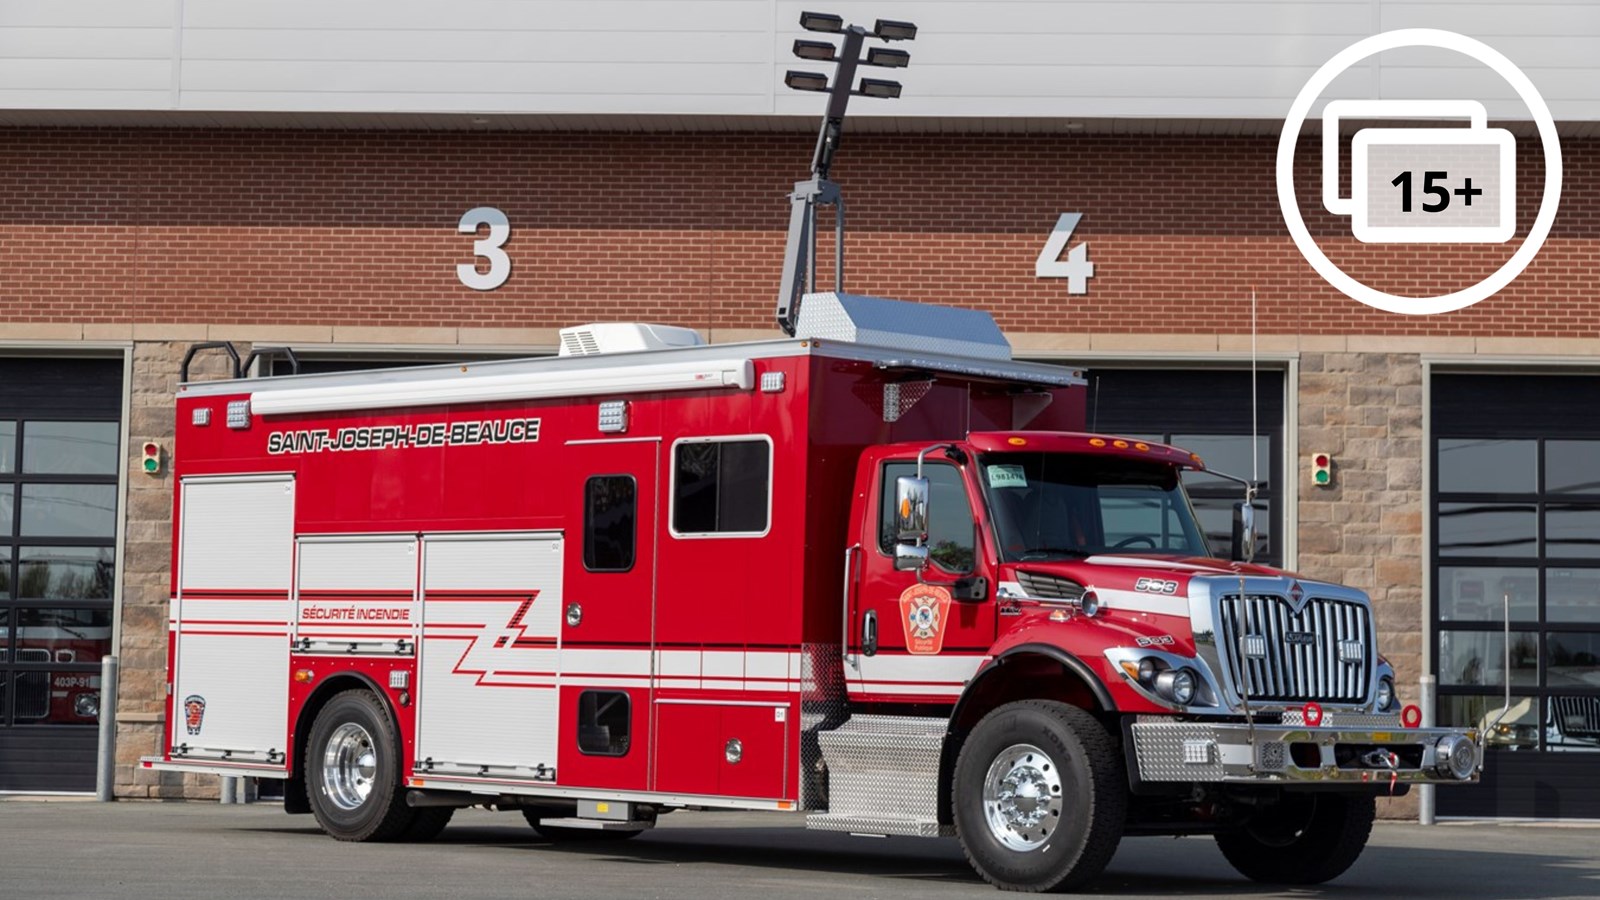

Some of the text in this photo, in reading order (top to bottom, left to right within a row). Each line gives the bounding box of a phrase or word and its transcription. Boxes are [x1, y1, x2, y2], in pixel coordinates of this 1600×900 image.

[456, 206, 511, 290] 3
[1035, 212, 1094, 294] 4
[267, 418, 541, 454] SAINT-JOSEPH-DE-BEAUCE
[302, 604, 410, 620] SÉCURITÉ INCENDIE
